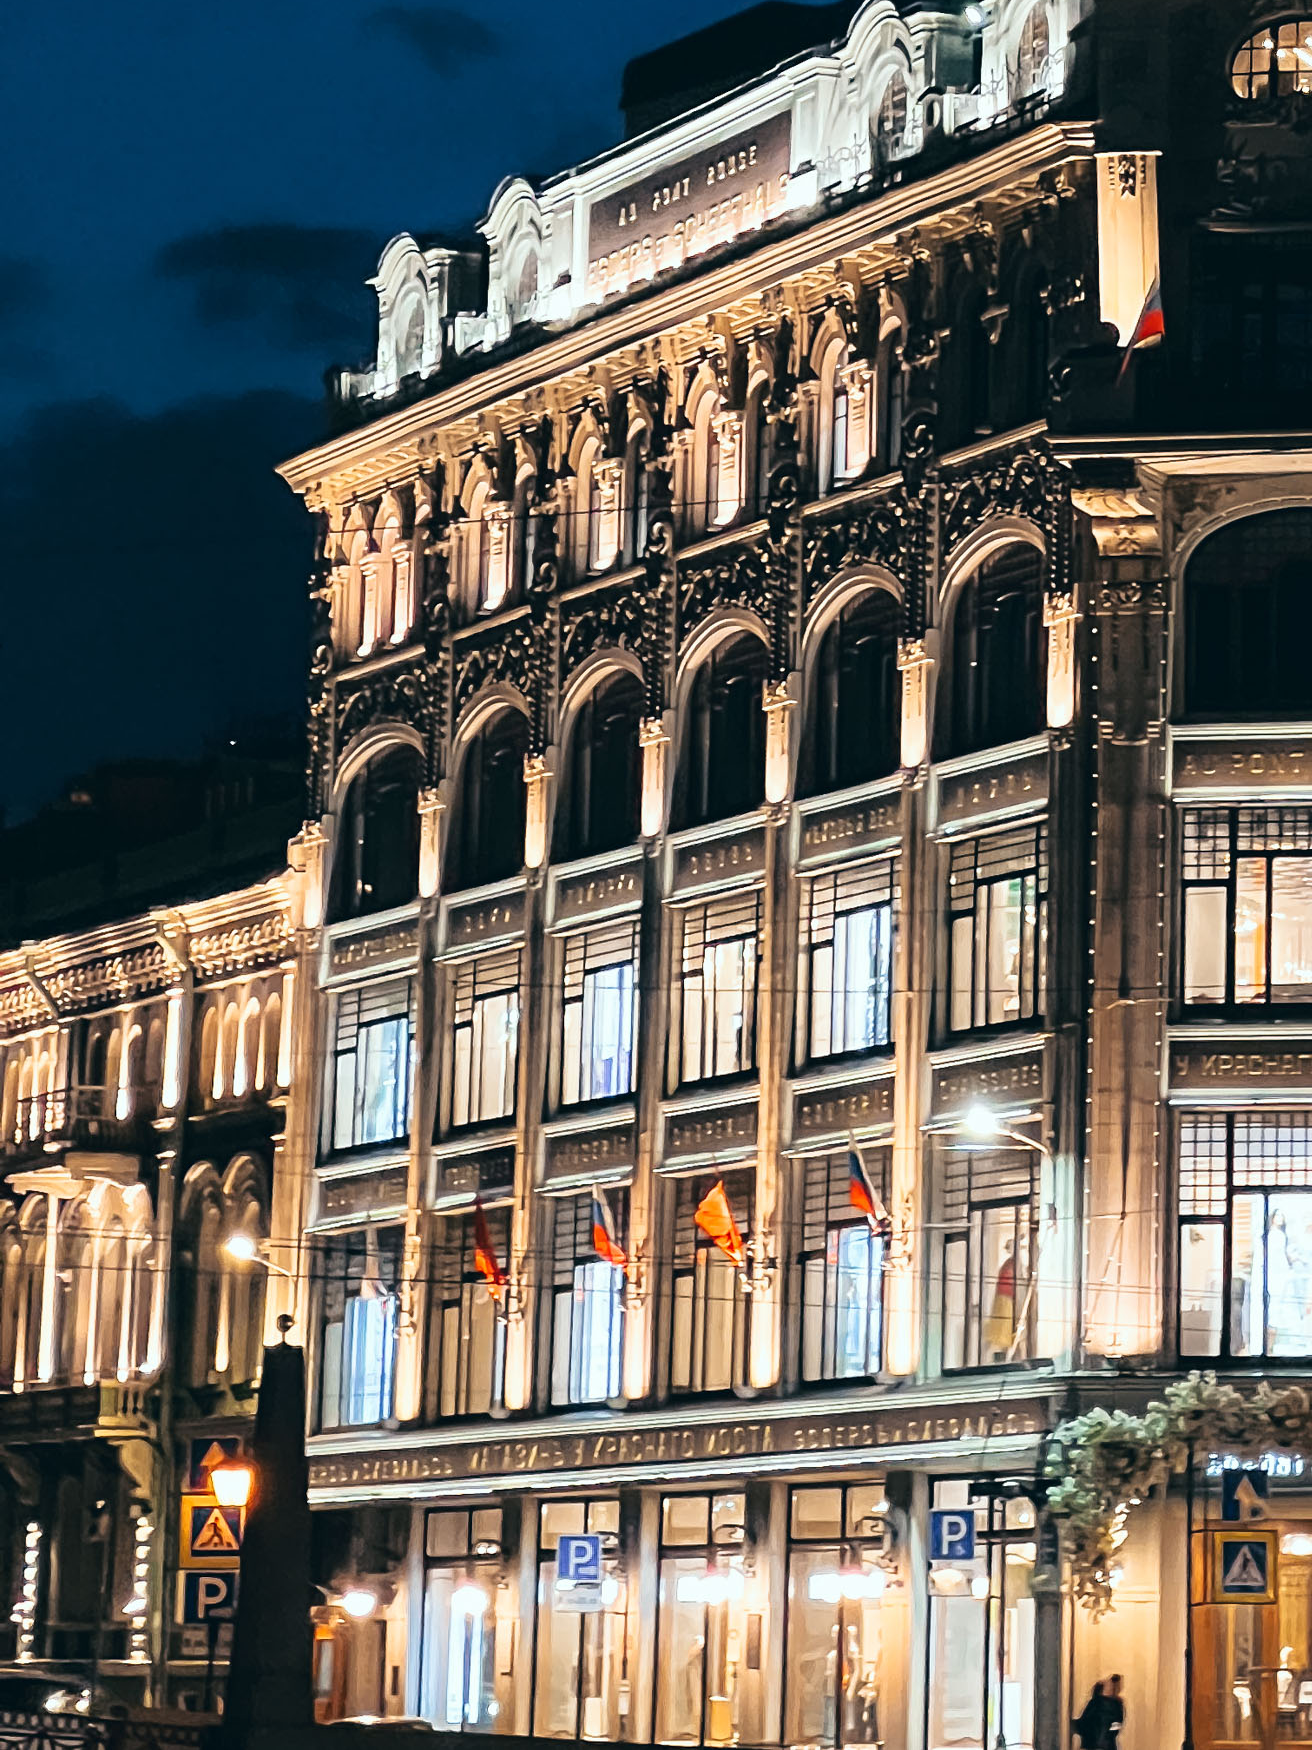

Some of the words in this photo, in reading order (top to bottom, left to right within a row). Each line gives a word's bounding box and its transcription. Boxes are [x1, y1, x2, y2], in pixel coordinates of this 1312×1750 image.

[1181, 754, 1216, 775] AU
[1229, 752, 1305, 775] PONT
[941, 1515, 967, 1555] P
[568, 1539, 593, 1577] P
[197, 1576, 227, 1619] P
